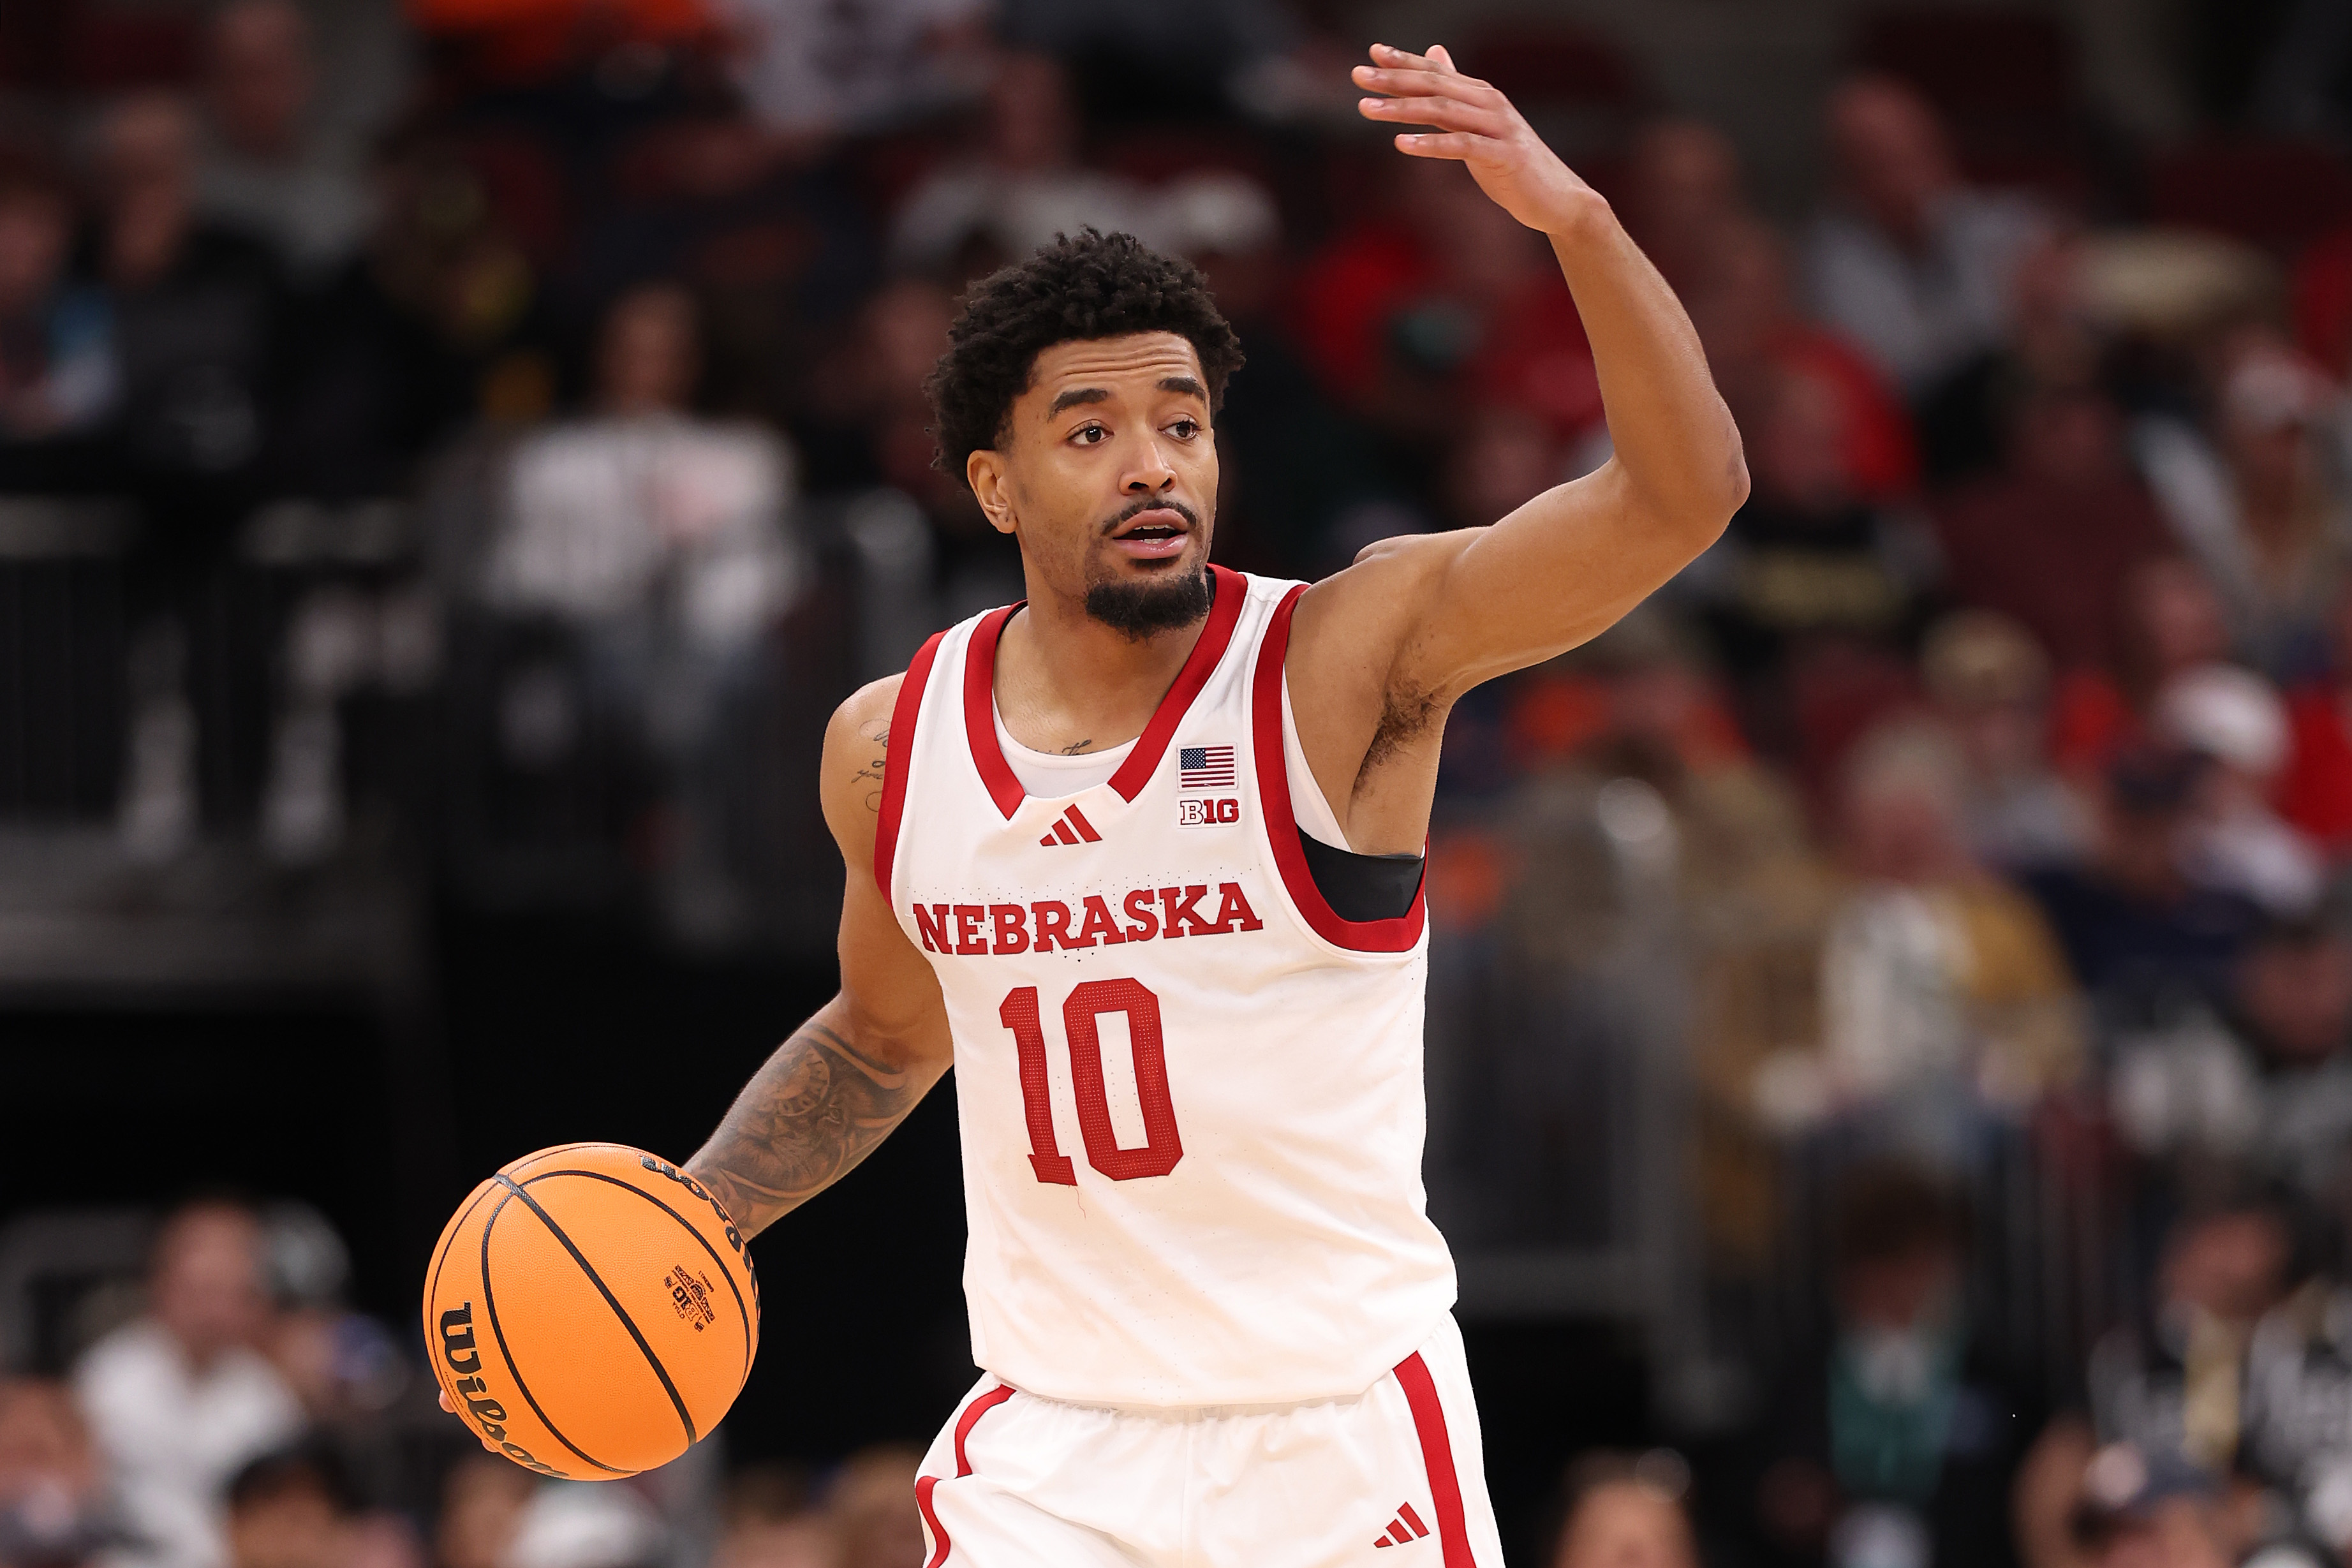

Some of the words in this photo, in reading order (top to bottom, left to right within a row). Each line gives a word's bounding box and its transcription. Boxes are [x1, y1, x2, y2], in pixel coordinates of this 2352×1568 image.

[913, 882, 1263, 956] NEBRASKA
[999, 977, 1183, 1186] 10
[440, 1301, 570, 1477] Wilson
